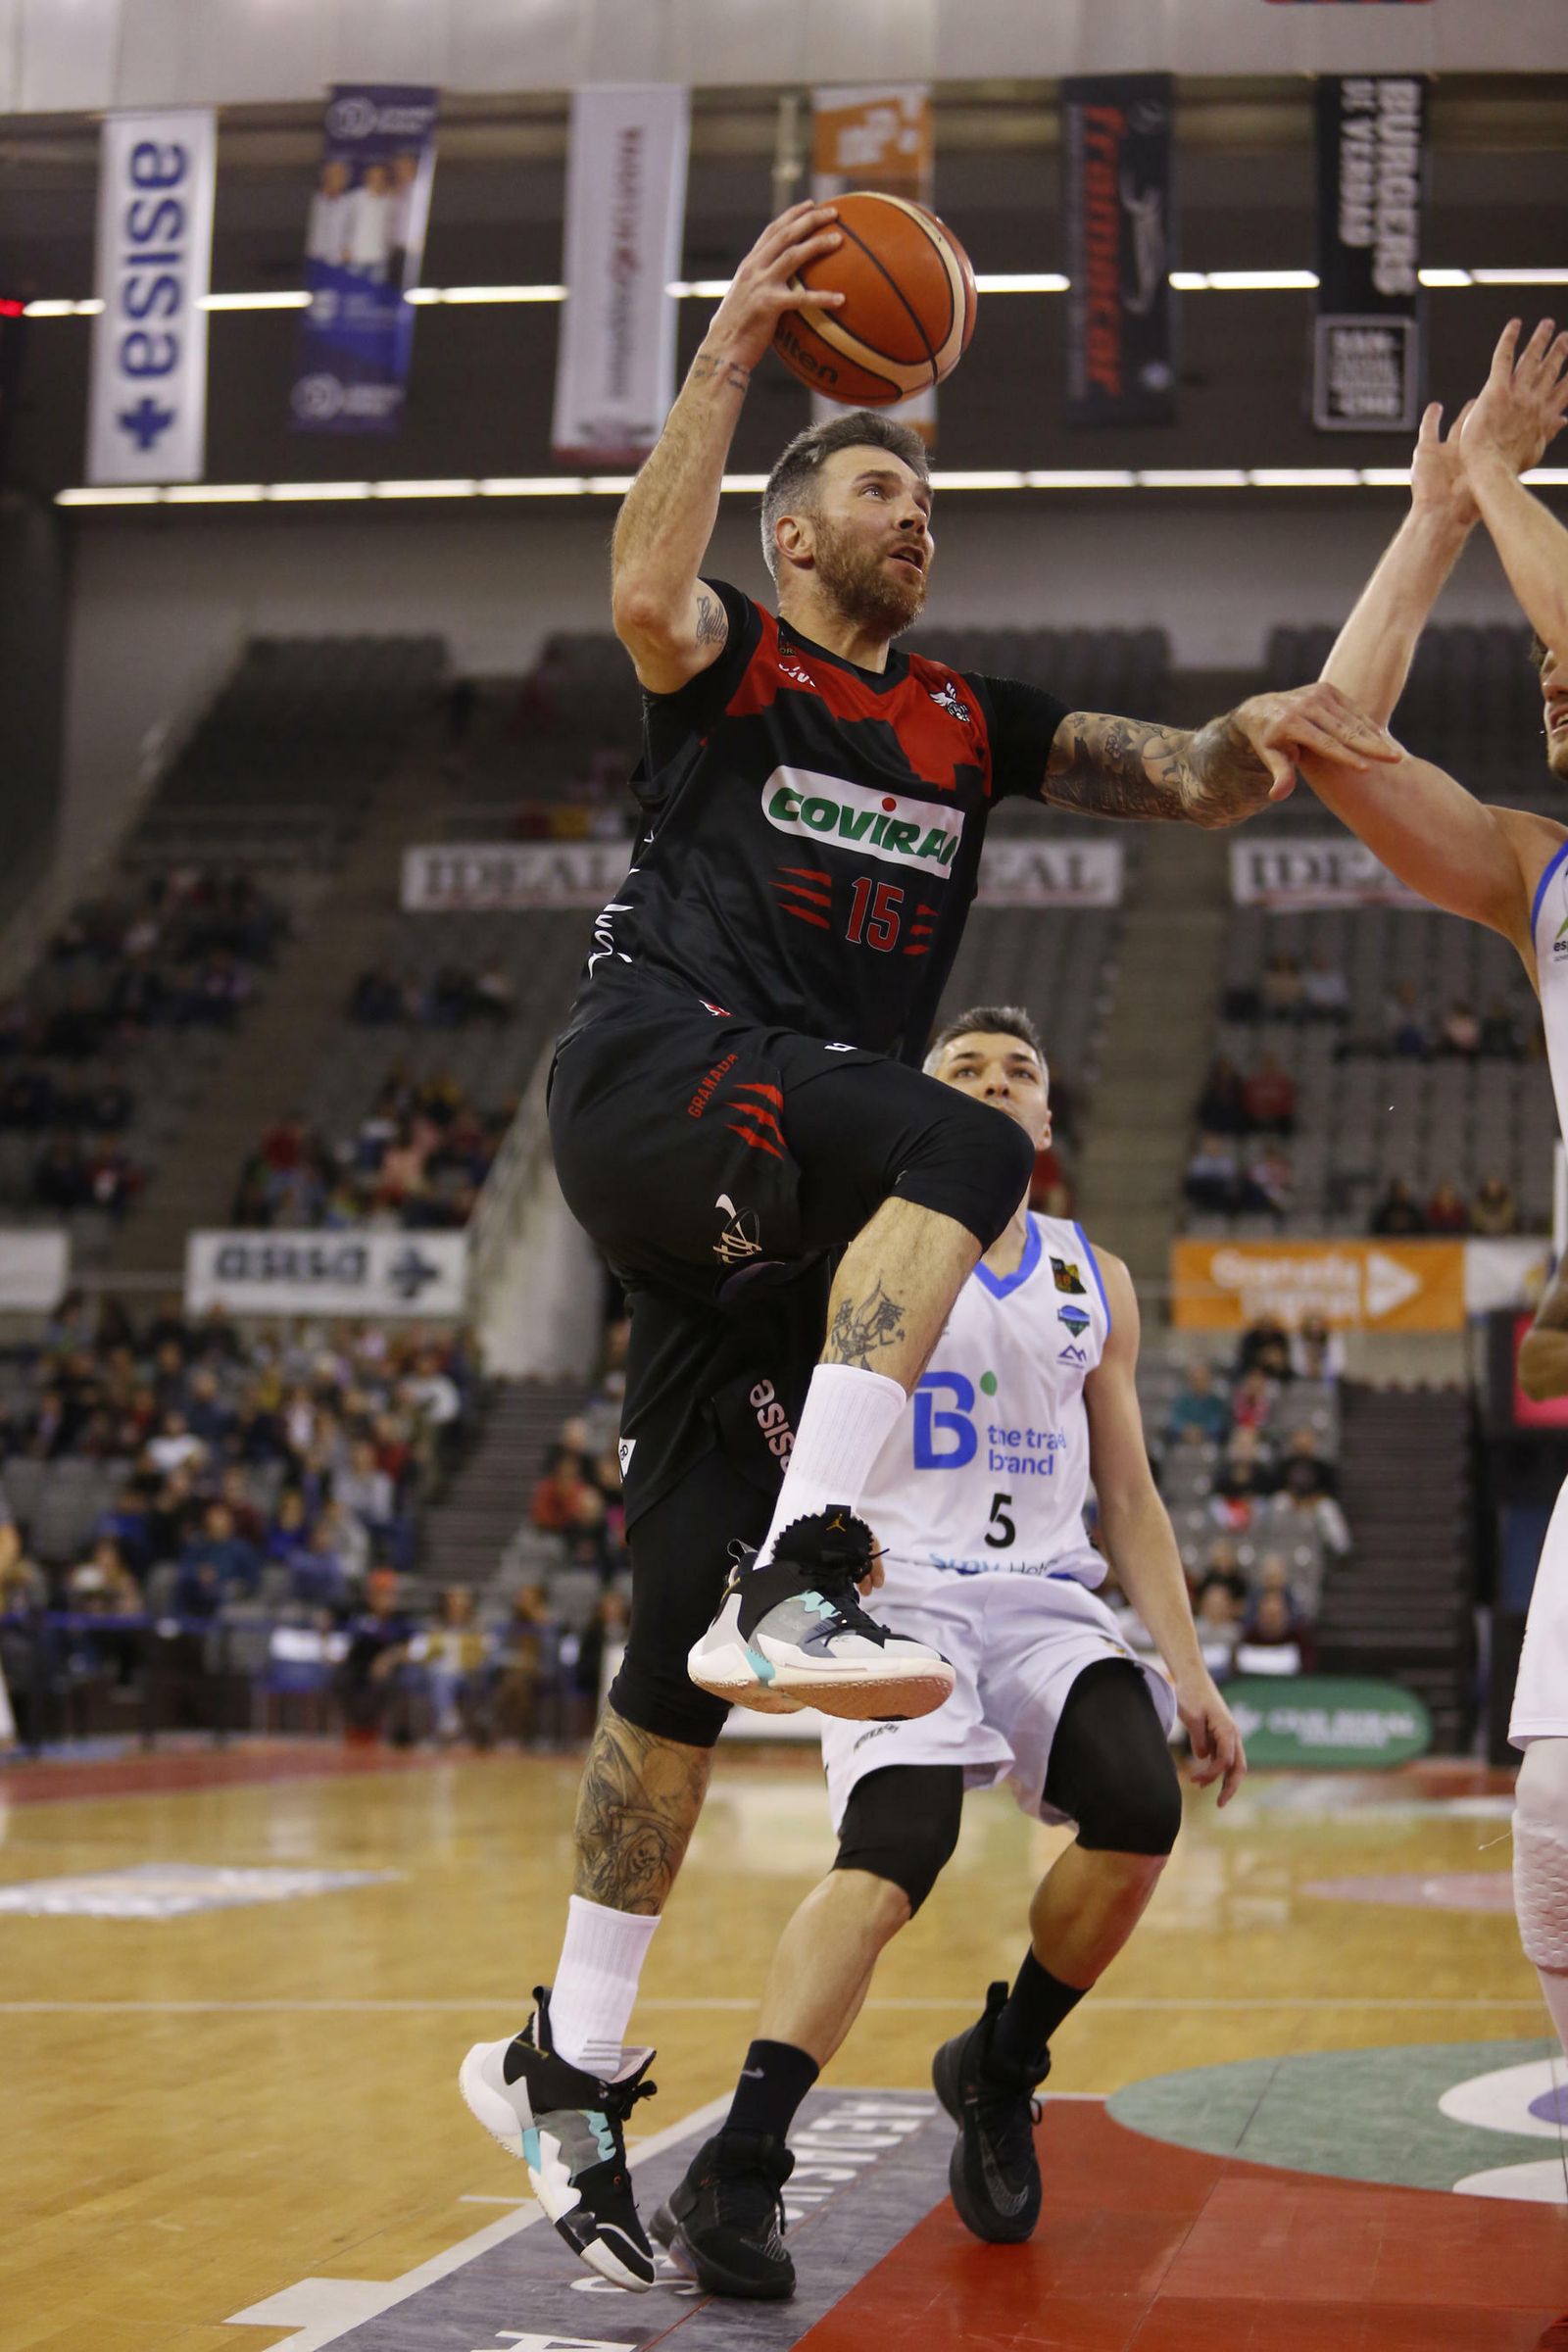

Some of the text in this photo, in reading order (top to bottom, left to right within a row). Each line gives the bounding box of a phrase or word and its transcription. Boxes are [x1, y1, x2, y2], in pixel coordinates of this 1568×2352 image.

[121, 140, 185, 379] asisa
[845, 876, 905, 953] 15
[688, 1054, 737, 1118] GRANADA
[984, 1493, 1016, 1548] 5
